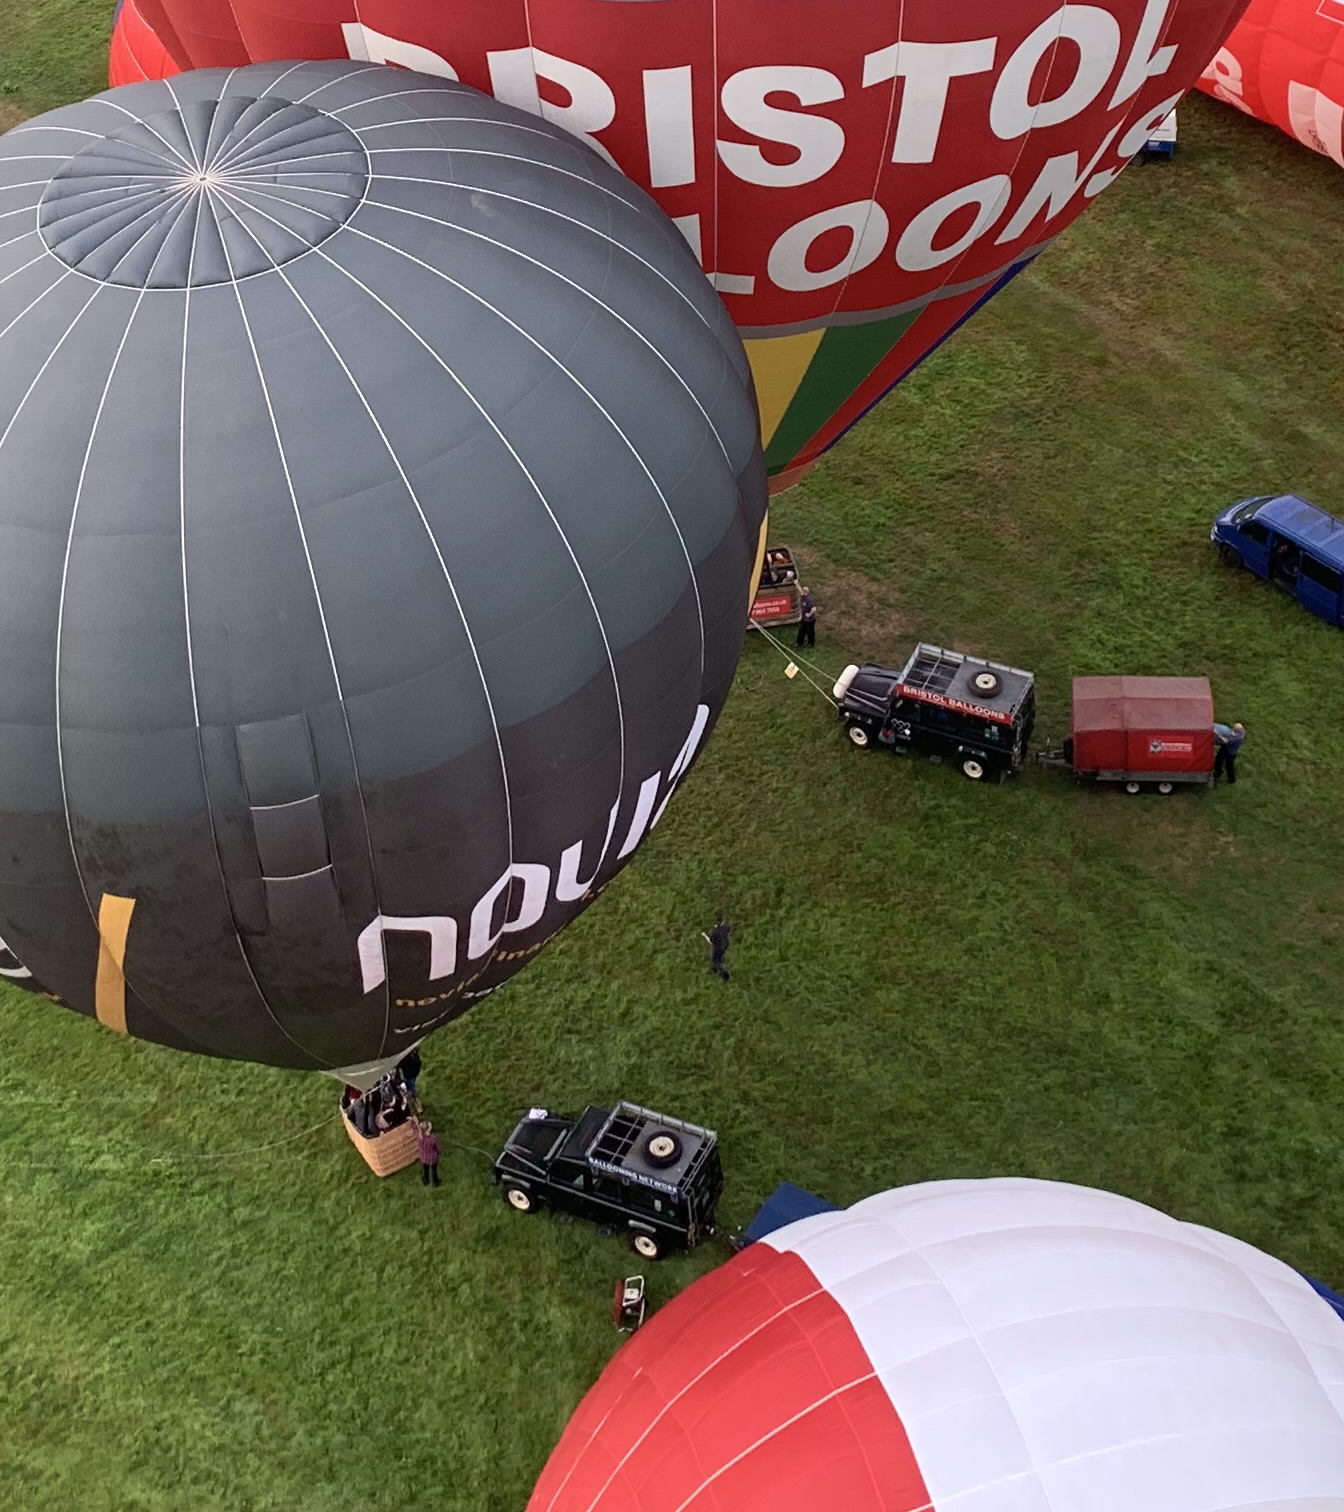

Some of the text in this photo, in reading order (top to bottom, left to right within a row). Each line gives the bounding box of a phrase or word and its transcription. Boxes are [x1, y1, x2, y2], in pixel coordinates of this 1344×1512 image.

[903, 685, 1006, 720] BRISTOL BALLOONS
[588, 1156, 678, 1193] BALLOONING NETWORK
